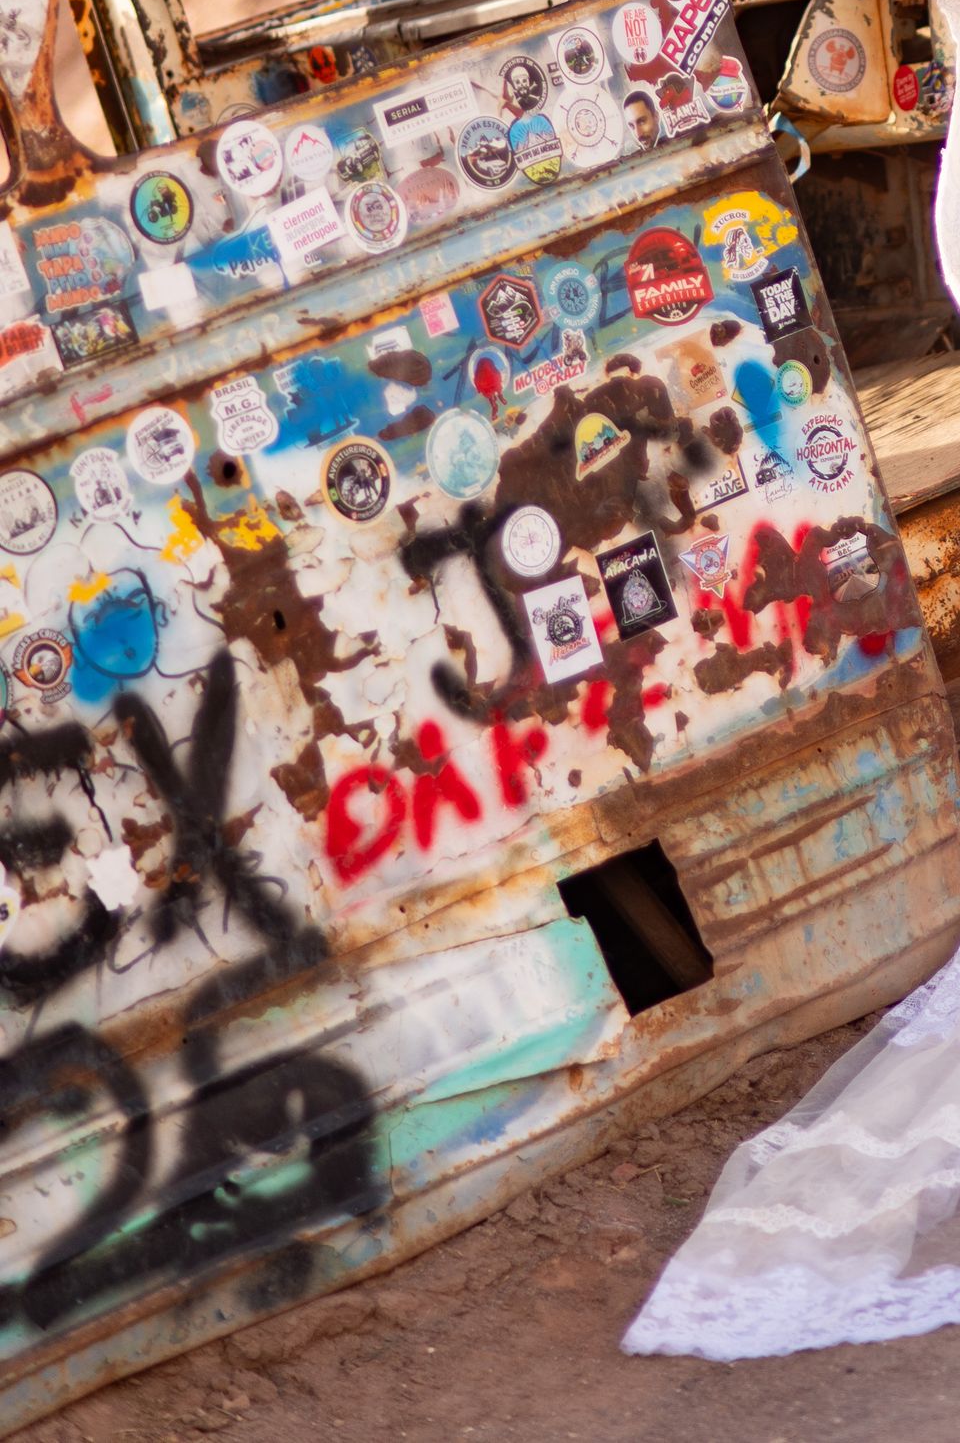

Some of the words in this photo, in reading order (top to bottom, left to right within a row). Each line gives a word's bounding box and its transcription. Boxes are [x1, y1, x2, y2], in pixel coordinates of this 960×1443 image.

[623, 9, 635, 21] WE
[634, 7, 647, 20] ARE
[623, 18, 648, 38] NOT
[627, 37, 650, 48] DATING
[428, 87, 463, 107] TRIPPERS
[391, 104, 421, 122] SERIAL
[391, 116, 430, 135] OVERLAND
[283, 202, 325, 230] clermont
[714, 211, 748, 230] XUCROS
[634, 275, 704, 303] FAMILY
[760, 277, 794, 298] TODAY
[637, 286, 706, 311] EXPEDITION
[764, 294, 776, 309] IS
[775, 288, 795, 305] THE
[767, 299, 797, 324] DAY
[549, 362, 586, 387] CRAZY
[214, 378, 252, 399] BRASIL
[224, 398, 257, 416] M.G.
[227, 418, 268, 440] LIBERDADE
[801, 414, 843, 436] EXPEDIÇÃO
[796, 437, 857, 462] HORIZONTAL
[328, 445, 377, 480] AVENTUREIROS
[713, 477, 743, 500] ALIVE
[808, 469, 855, 493] ATACAMA
[826, 541, 849, 555] ATACAMA
[604, 547, 658, 580] ATACAMA
